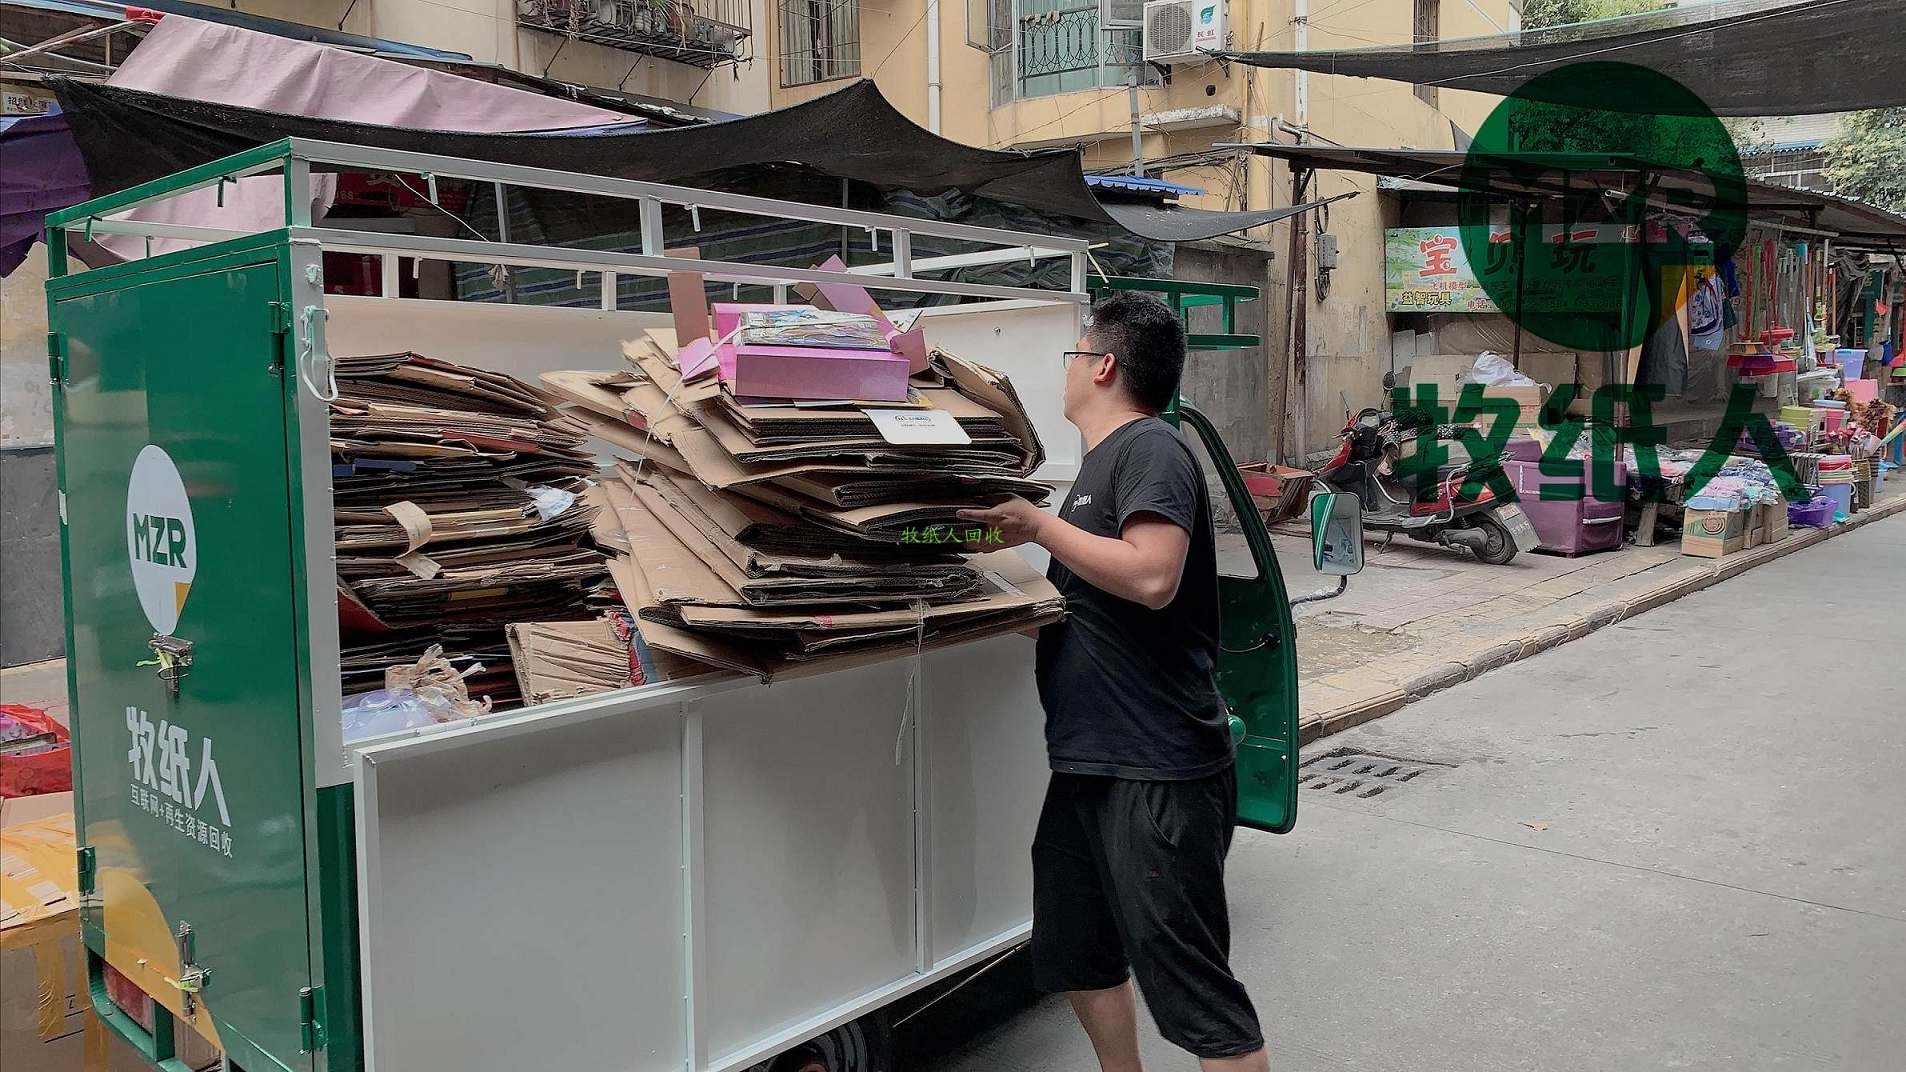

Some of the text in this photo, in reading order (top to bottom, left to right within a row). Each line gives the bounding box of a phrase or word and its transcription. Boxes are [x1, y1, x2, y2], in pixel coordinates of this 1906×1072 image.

[1402, 291, 1452, 306] 益智玩具
[133, 512, 188, 569] MZR
[125, 706, 232, 828] 牧纸人
[130, 783, 233, 859] 互联网+再生资源回收
